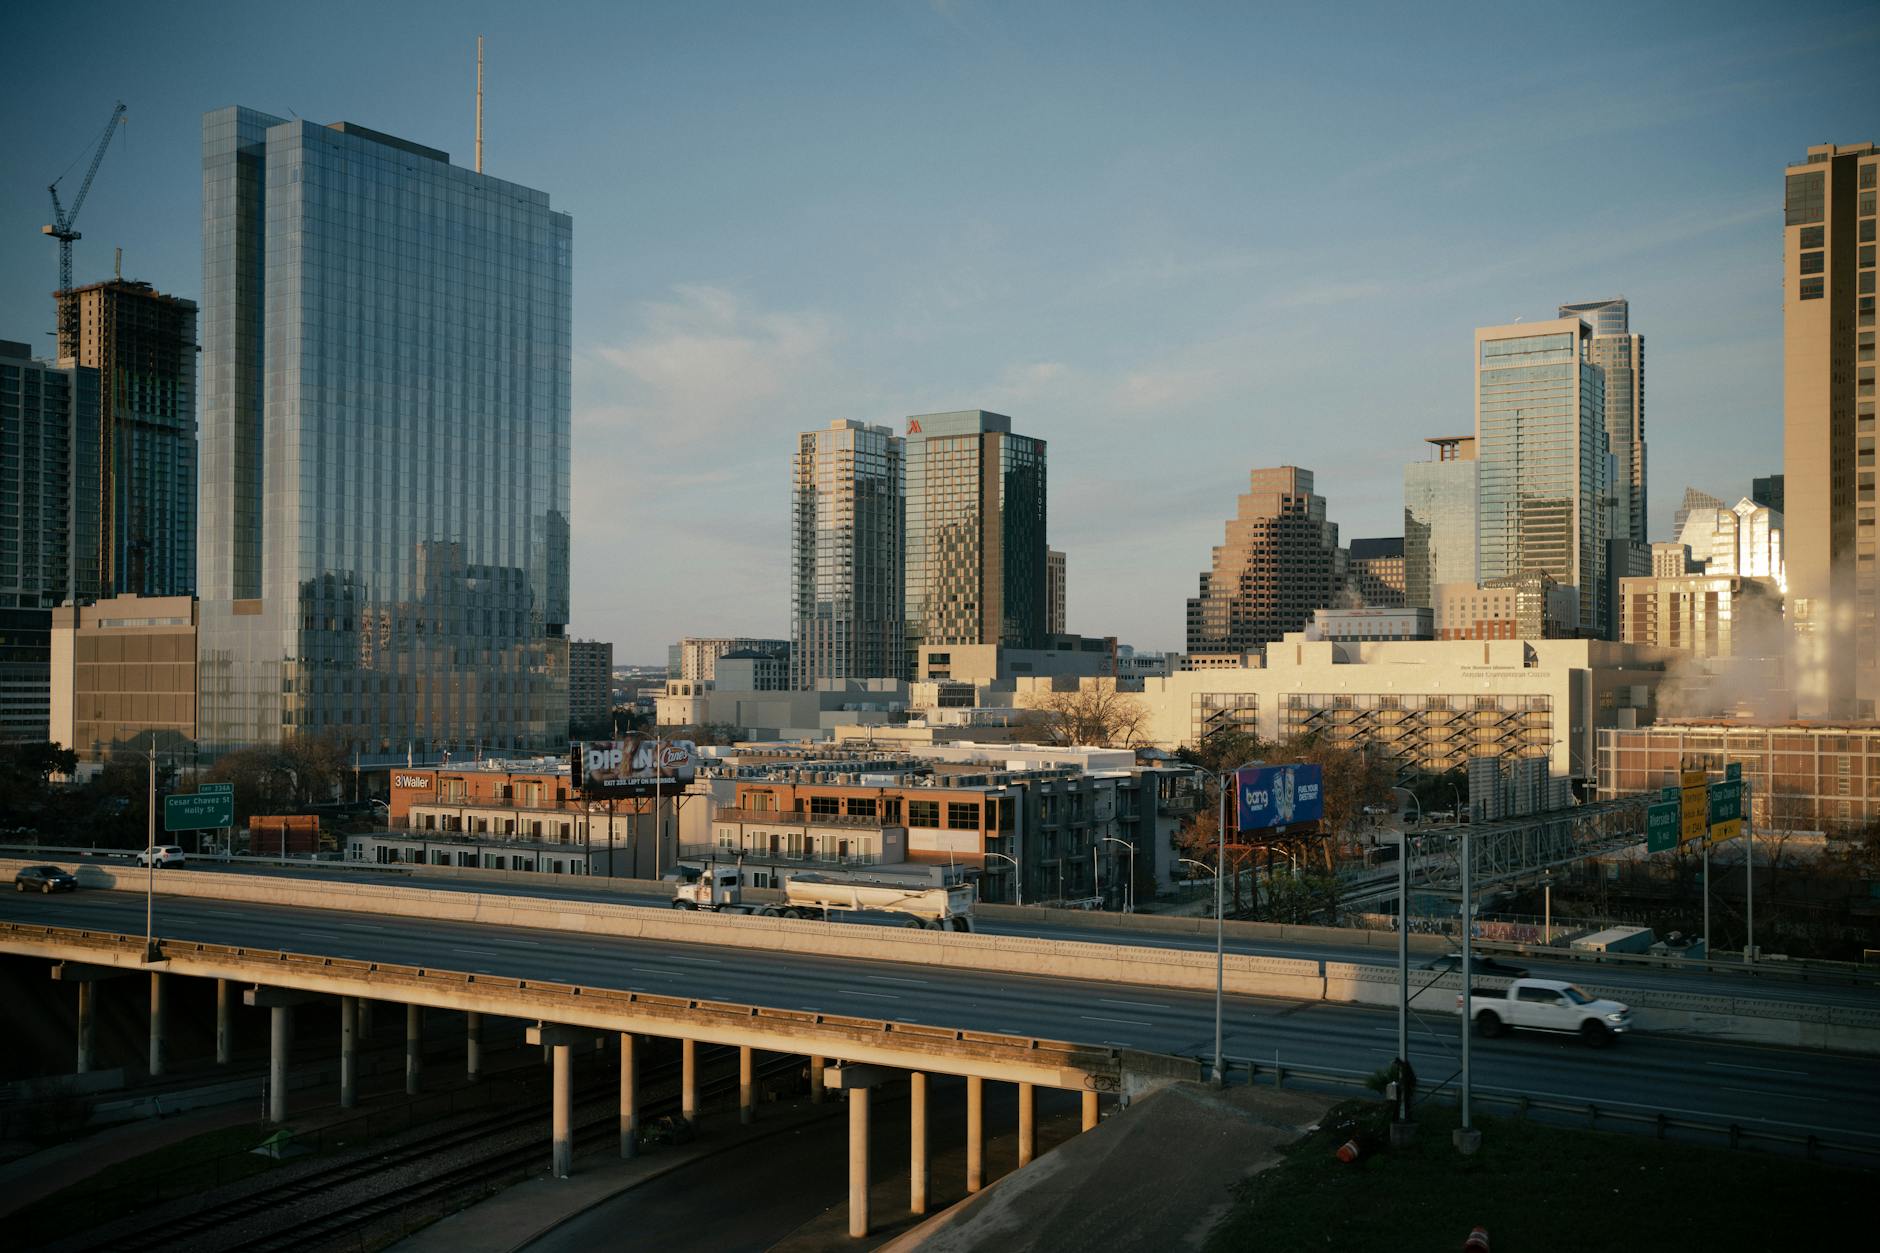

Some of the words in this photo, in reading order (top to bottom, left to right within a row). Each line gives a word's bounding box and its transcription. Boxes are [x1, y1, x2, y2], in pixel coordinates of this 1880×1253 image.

[589, 749, 623, 770] DIP
[1246, 787, 1269, 807] bang
[184, 806, 204, 814] Holly
[1650, 814, 1670, 827] Riverside
